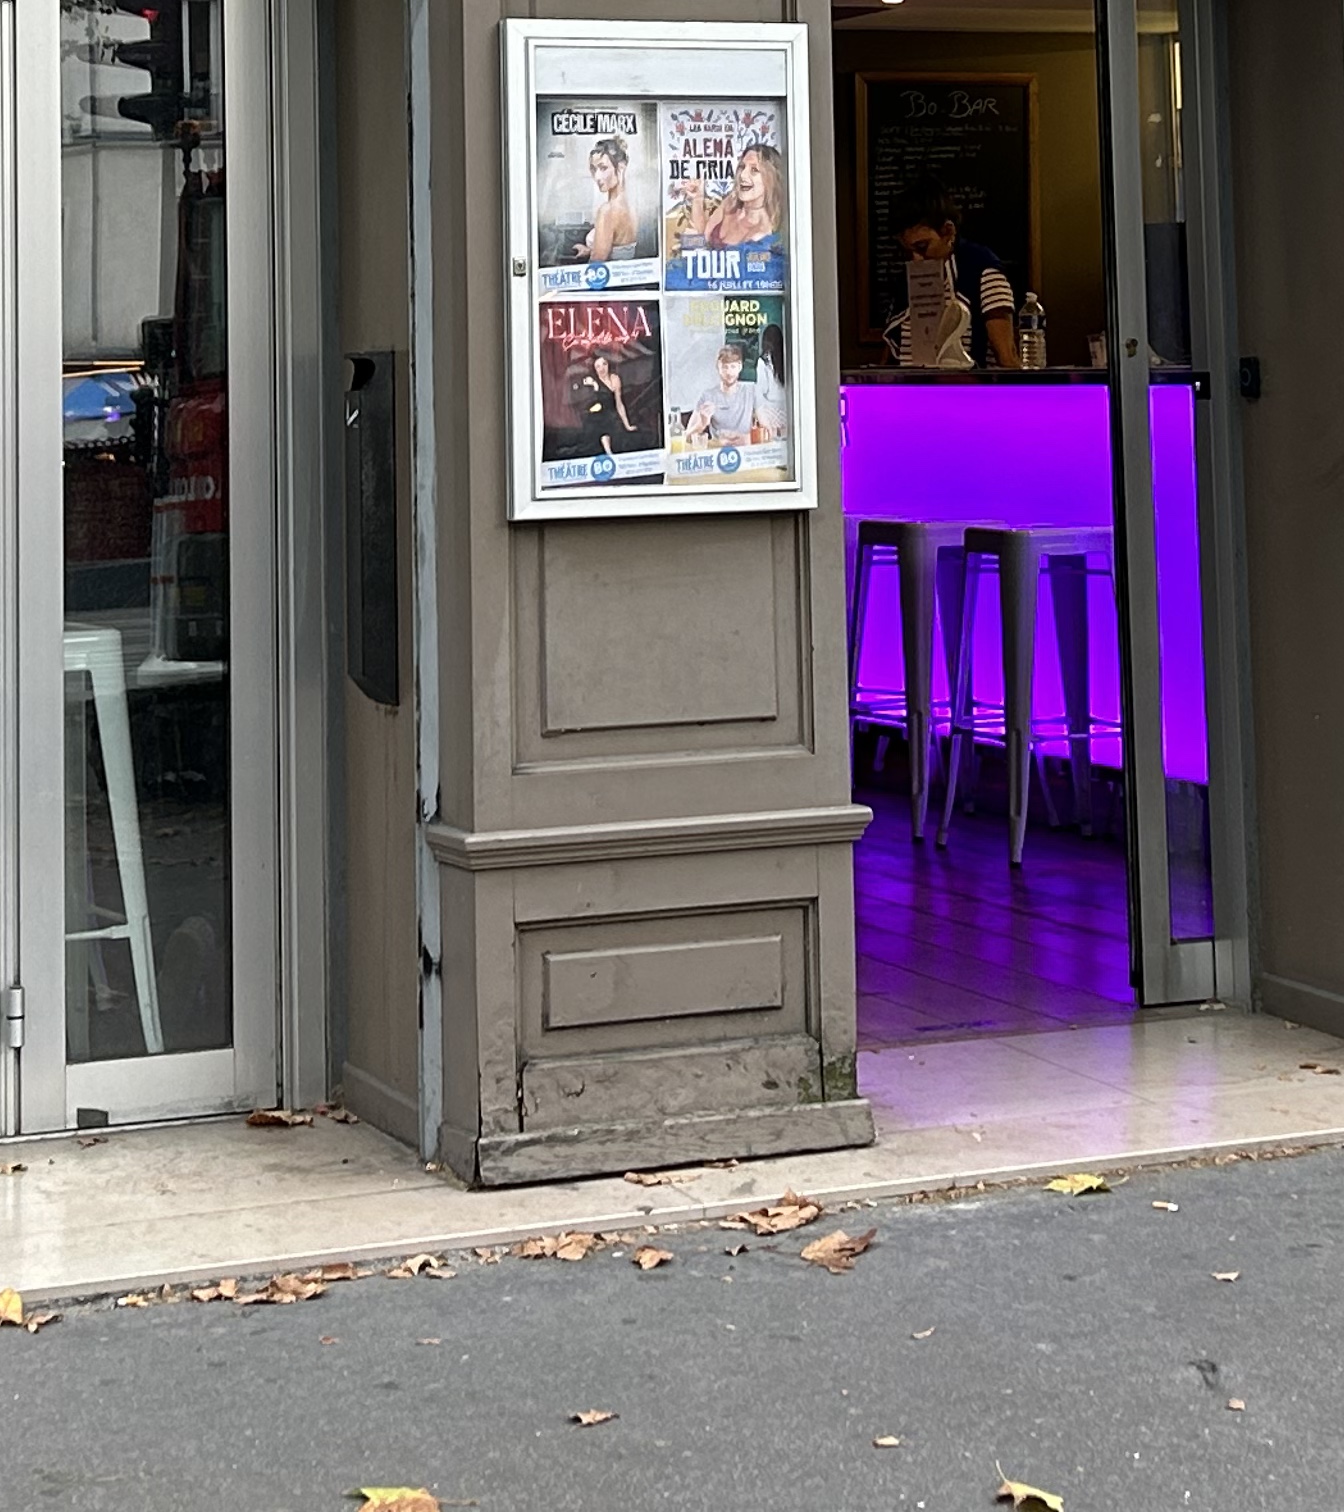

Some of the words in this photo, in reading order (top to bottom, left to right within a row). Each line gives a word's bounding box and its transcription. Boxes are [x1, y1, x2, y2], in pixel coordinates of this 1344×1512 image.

[948, 90, 999, 118] BAR
[553, 108, 595, 133] CÉCILE
[597, 113, 634, 133] MARX
[669, 159, 690, 180] DE
[682, 250, 740, 279] TOUR
[542, 268, 582, 287] THÉÂTRE
[547, 306, 652, 338] ELENA
[548, 462, 588, 480] THÉÂTRE
[593, 460, 613, 476] BO
[676, 454, 714, 474] THÉÂTRE
